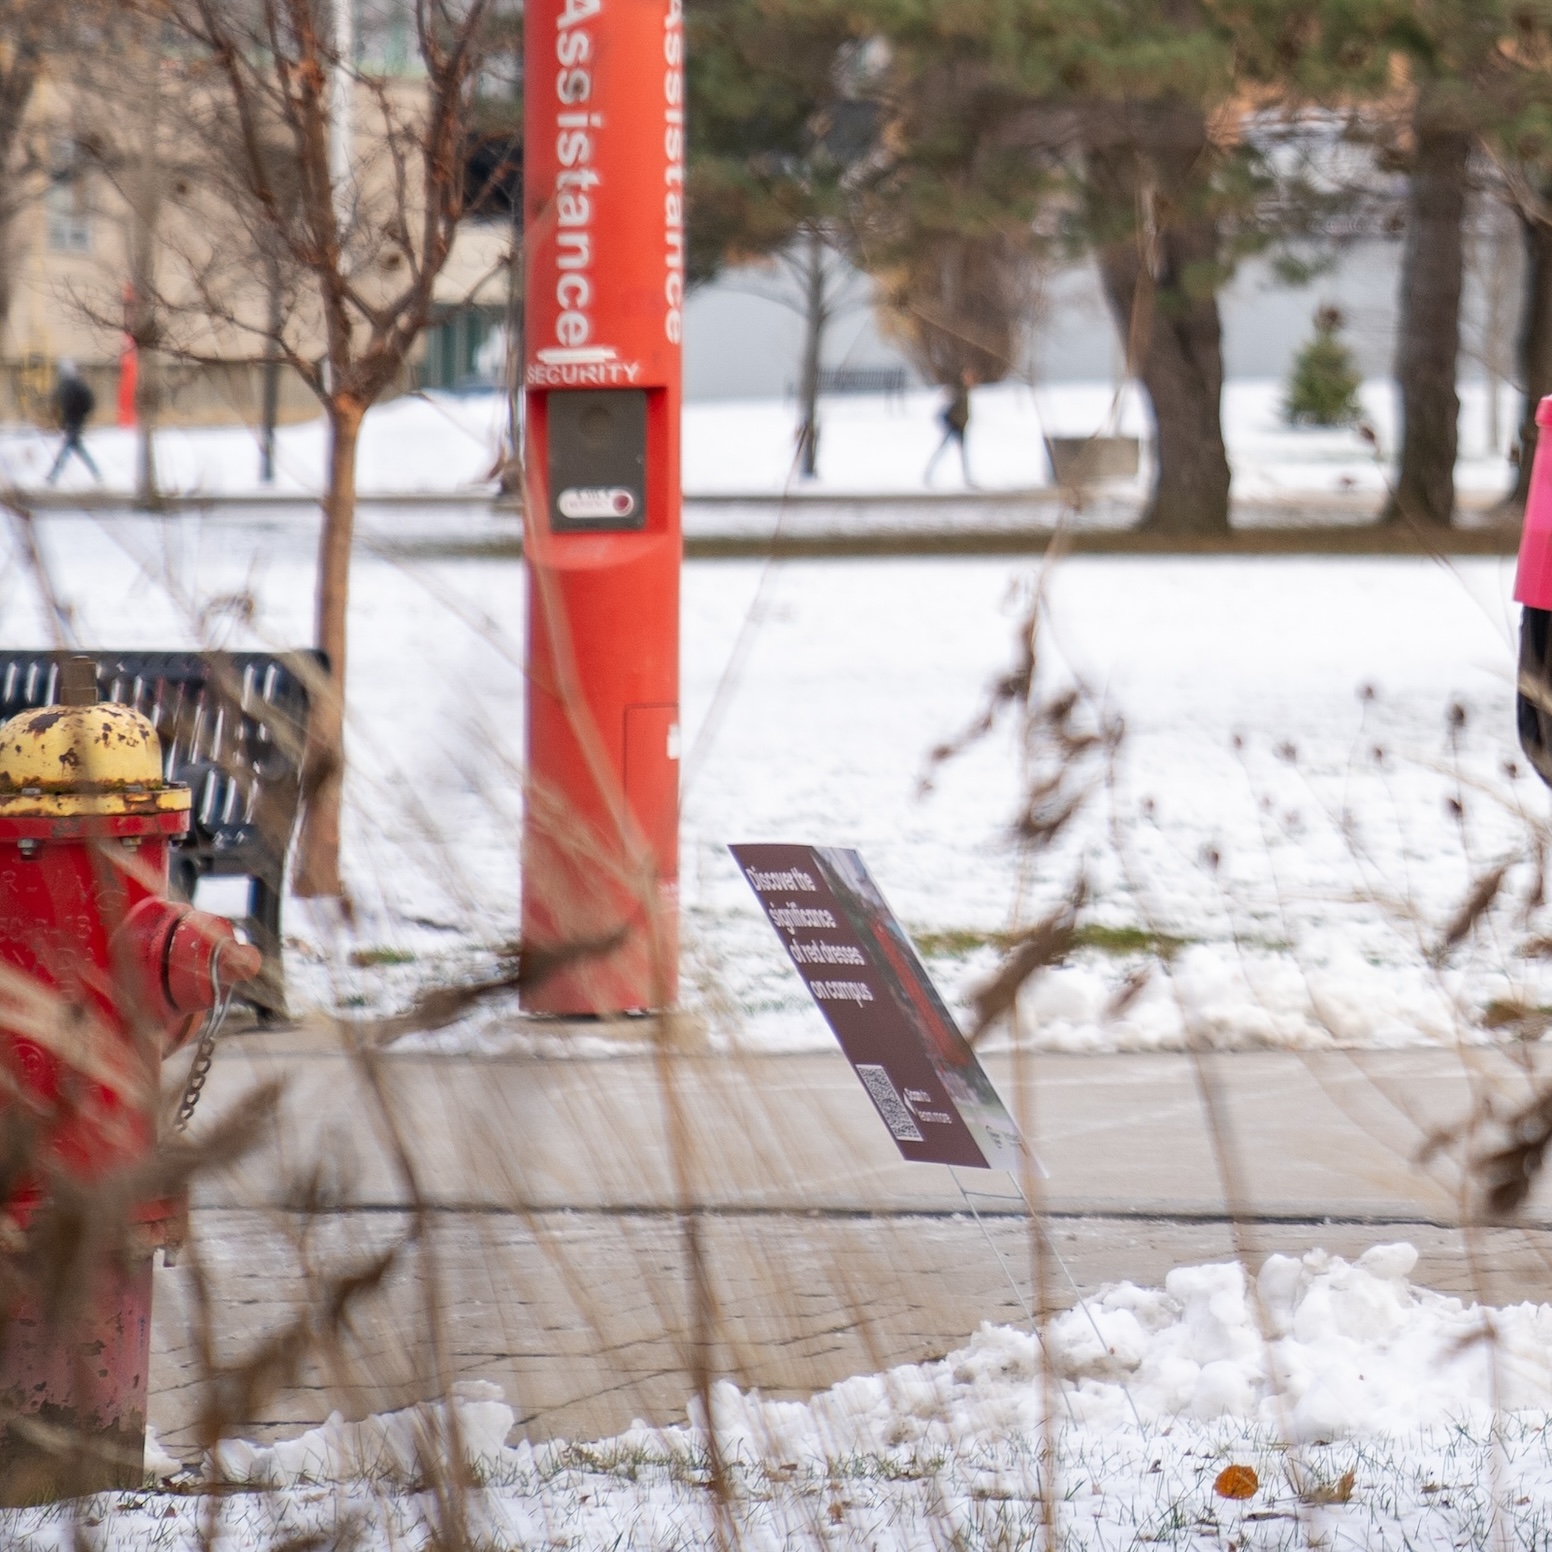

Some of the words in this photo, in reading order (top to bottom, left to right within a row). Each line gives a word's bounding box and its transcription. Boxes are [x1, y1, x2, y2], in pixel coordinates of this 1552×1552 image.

[527, 360, 640, 384] SECURITY
[746, 866, 797, 891] Discover
[791, 867, 816, 891] the
[769, 902, 836, 935] significance
[789, 938, 807, 963] of
[801, 940, 826, 963] red
[820, 940, 865, 965] dresses
[810, 981, 830, 999] on
[826, 981, 873, 1008] campus
